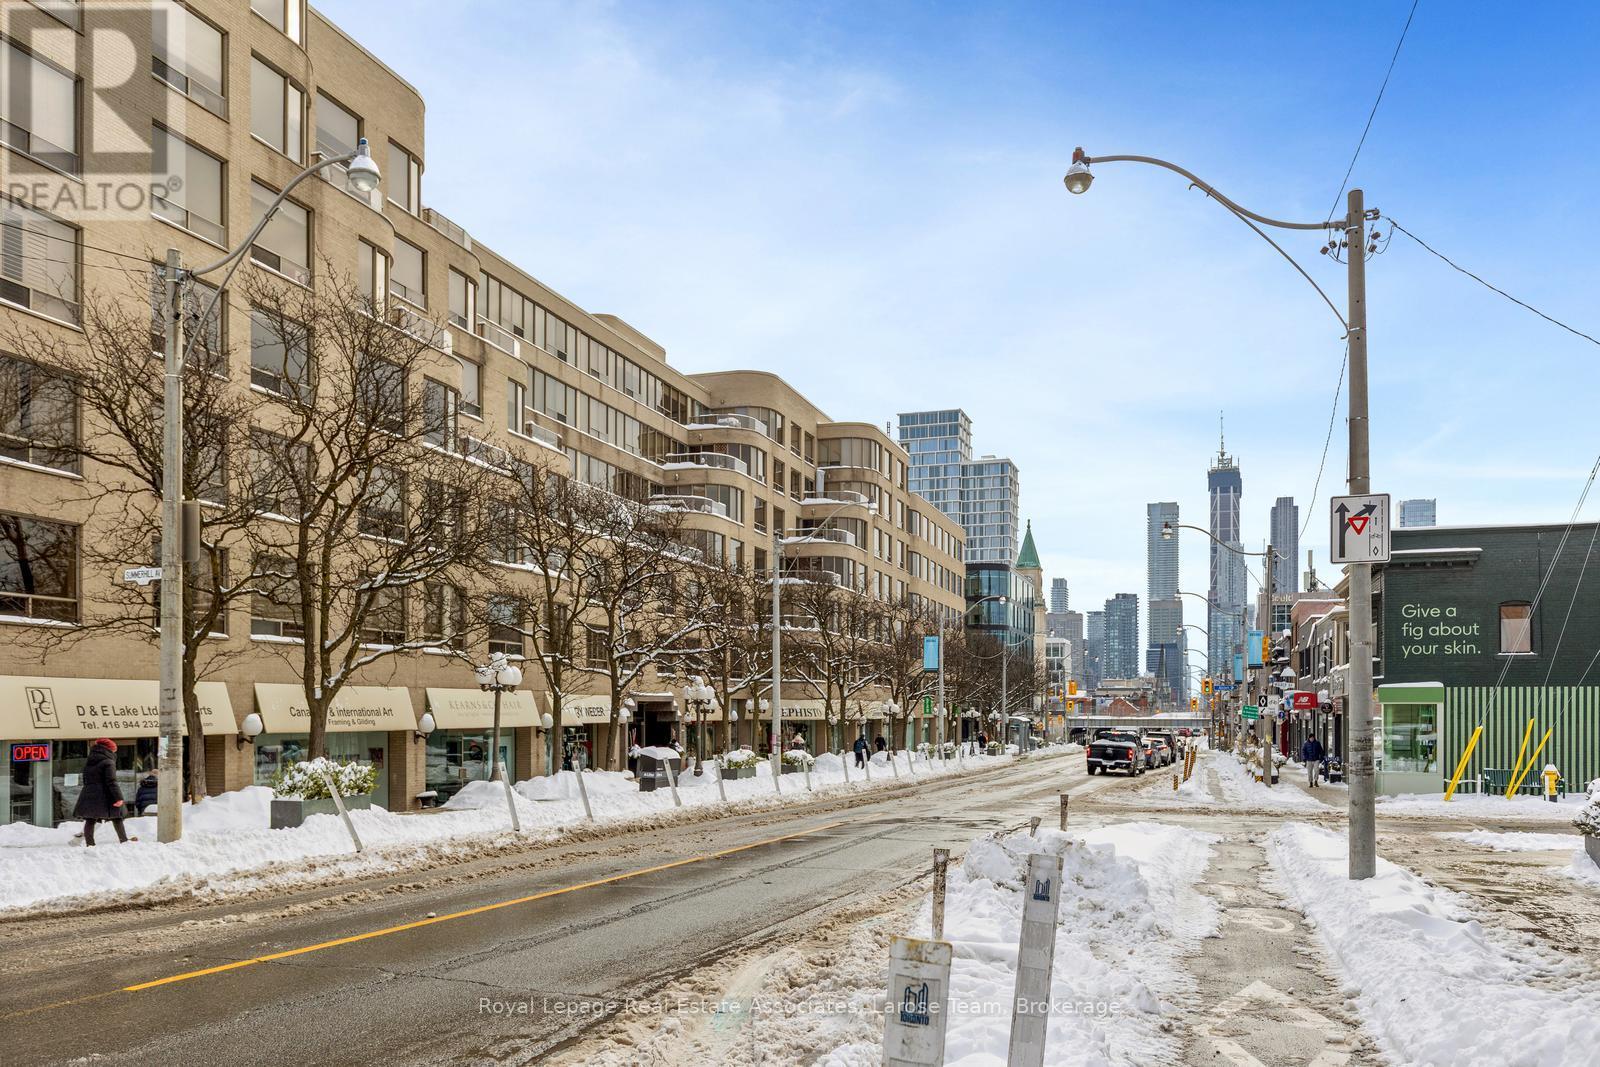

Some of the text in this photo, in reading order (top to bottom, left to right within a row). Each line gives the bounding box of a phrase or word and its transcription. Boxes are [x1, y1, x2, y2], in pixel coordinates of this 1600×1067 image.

[1401, 604, 1457, 618] Give a
[1401, 621, 1480, 640] fig about
[1401, 640, 1481, 659] your skin.
[76, 705, 86, 717] D
[89, 705, 99, 717] &
[100, 705, 110, 717] E
[111, 705, 139, 717] Lake
[199, 706, 213, 716] rts
[289, 706, 312, 718] Cana
[336, 707, 382, 717] international
[382, 707, 394, 717] Art
[781, 707, 822, 717] EPHISTO
[80, 721, 100, 730] Tel.
[102, 721, 121, 729] 416
[122, 720, 140, 729] 944
[142, 720, 160, 729] 232
[357, 718, 376, 726] Gilding
[14, 746, 48, 760] OPEN
